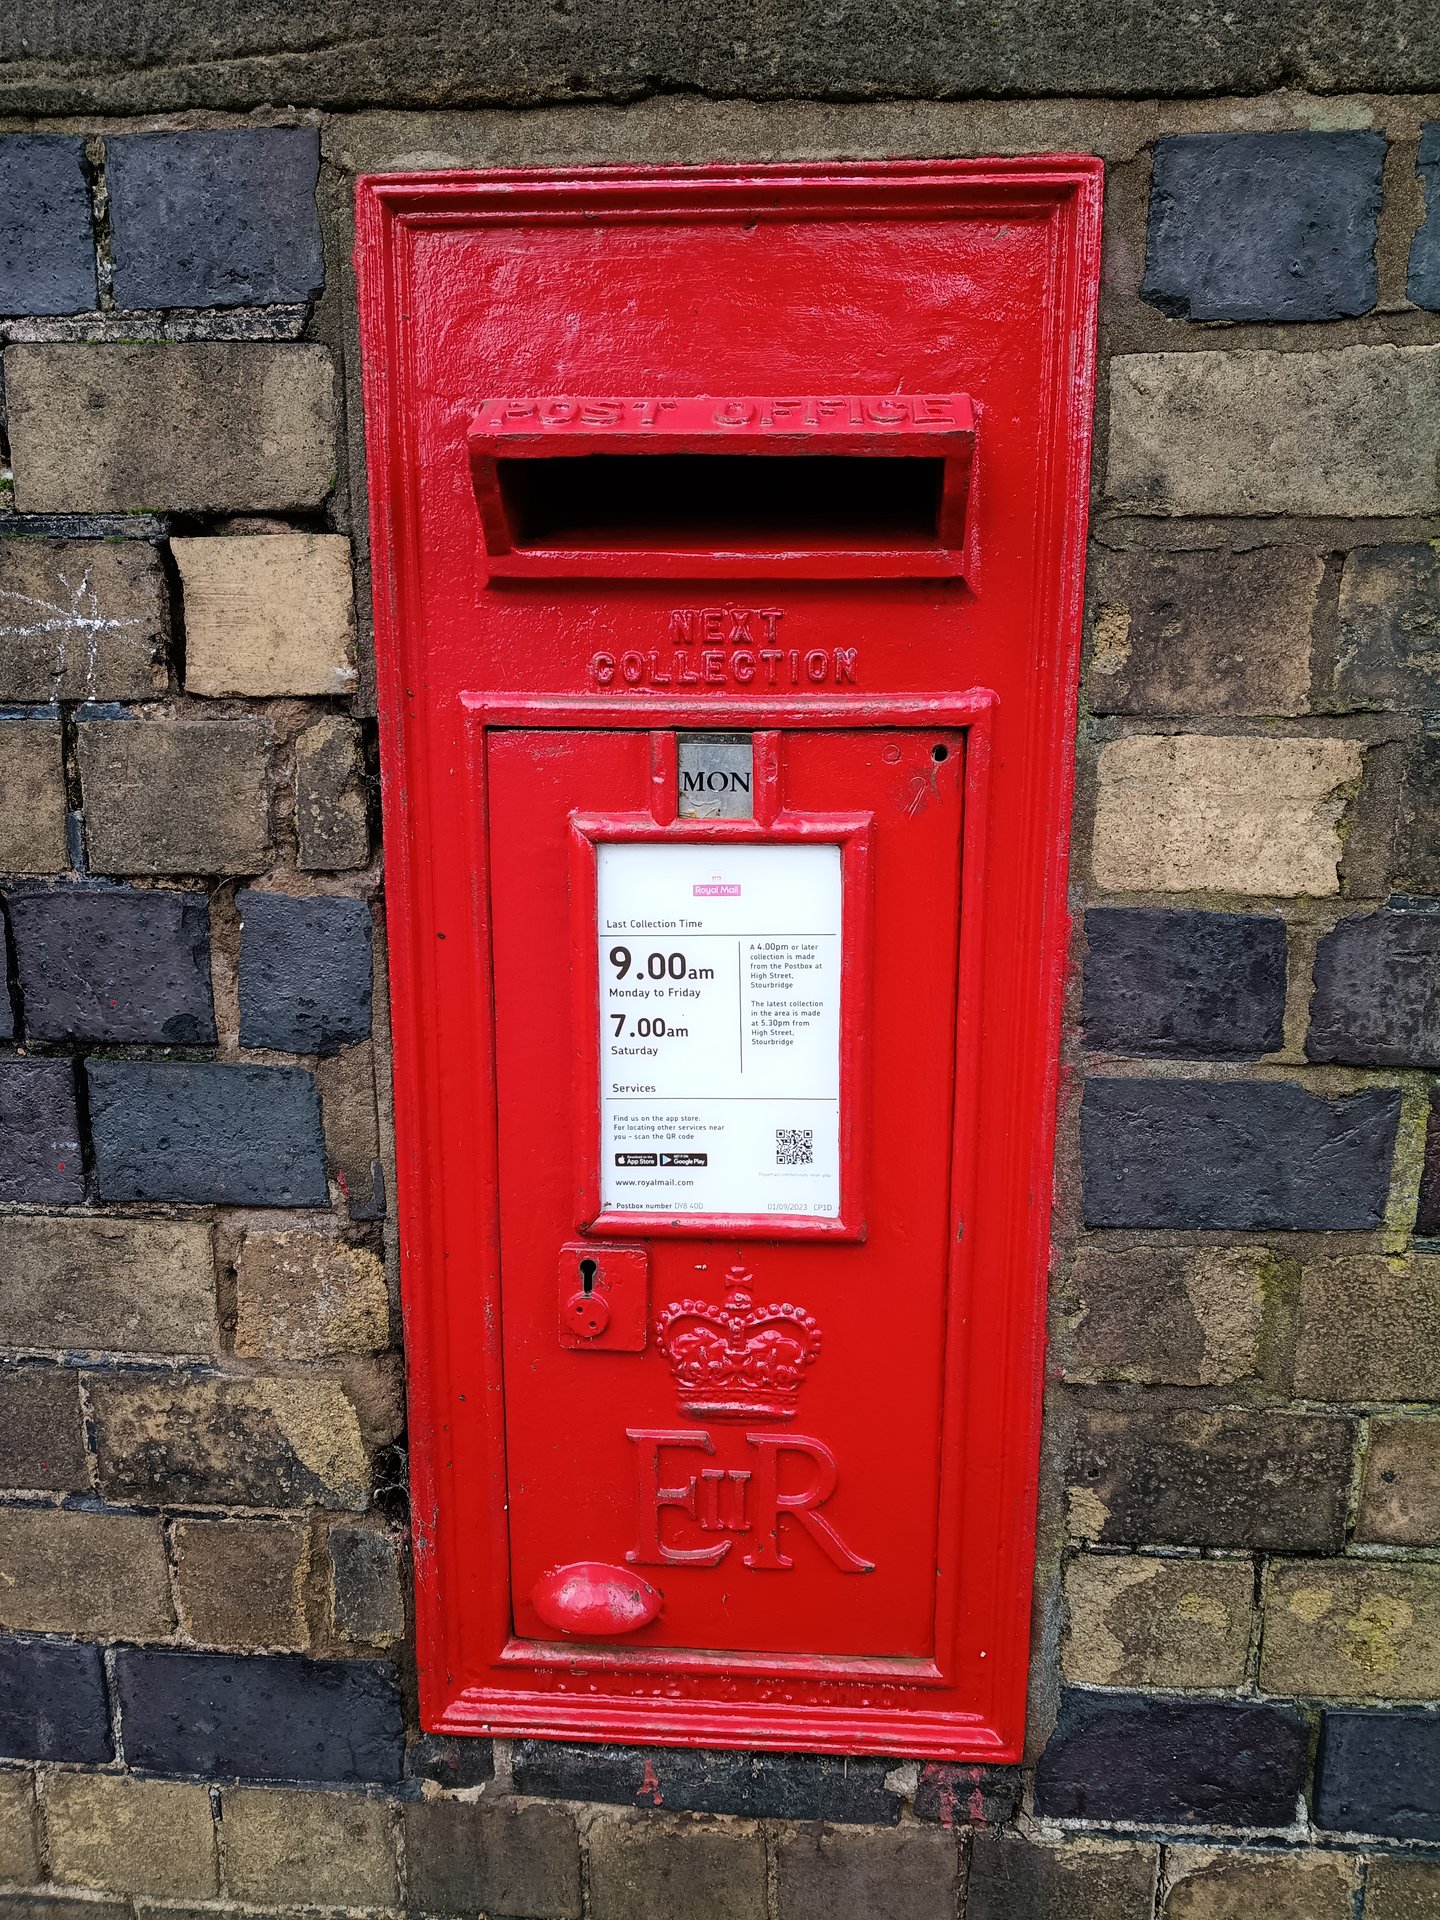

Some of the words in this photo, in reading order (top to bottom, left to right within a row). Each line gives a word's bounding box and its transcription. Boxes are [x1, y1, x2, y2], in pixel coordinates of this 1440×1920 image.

[489, 399, 678, 426] POST
[713, 398, 957, 425] OFFICE
[669, 608, 784, 643] NEXT
[590, 647, 858, 684] COLLECTION
[682, 771, 751, 793] MON
[695, 885, 719, 895] Royal
[720, 885, 739, 894] Mail
[606, 920, 627, 928] Last
[630, 919, 676, 928] Collection
[679, 919, 703, 928] Time
[757, 943, 789, 952] 4.00pm
[609, 945, 714, 981] 9.00am
[750, 972, 767, 980] High
[769, 972, 794, 980] Street,
[750, 981, 793, 989] Stourbridge
[609, 988, 650, 998] Monday
[654, 988, 664, 997] to
[668, 988, 701, 998] Friday
[610, 1014, 689, 1037] 7.00am
[761, 1019, 790, 1028] 5.30pm
[751, 1029, 768, 1037] High
[770, 1029, 794, 1037] Street,
[751, 1038, 794, 1046] Stourbridge
[611, 1046, 658, 1056] Saturday
[612, 1084, 656, 1093] Services
[627, 1124, 655, 1132] locating
[615, 1178, 694, 1188] www.royalmail.com
[767, 1203, 808, 1211] 01/09/2023
